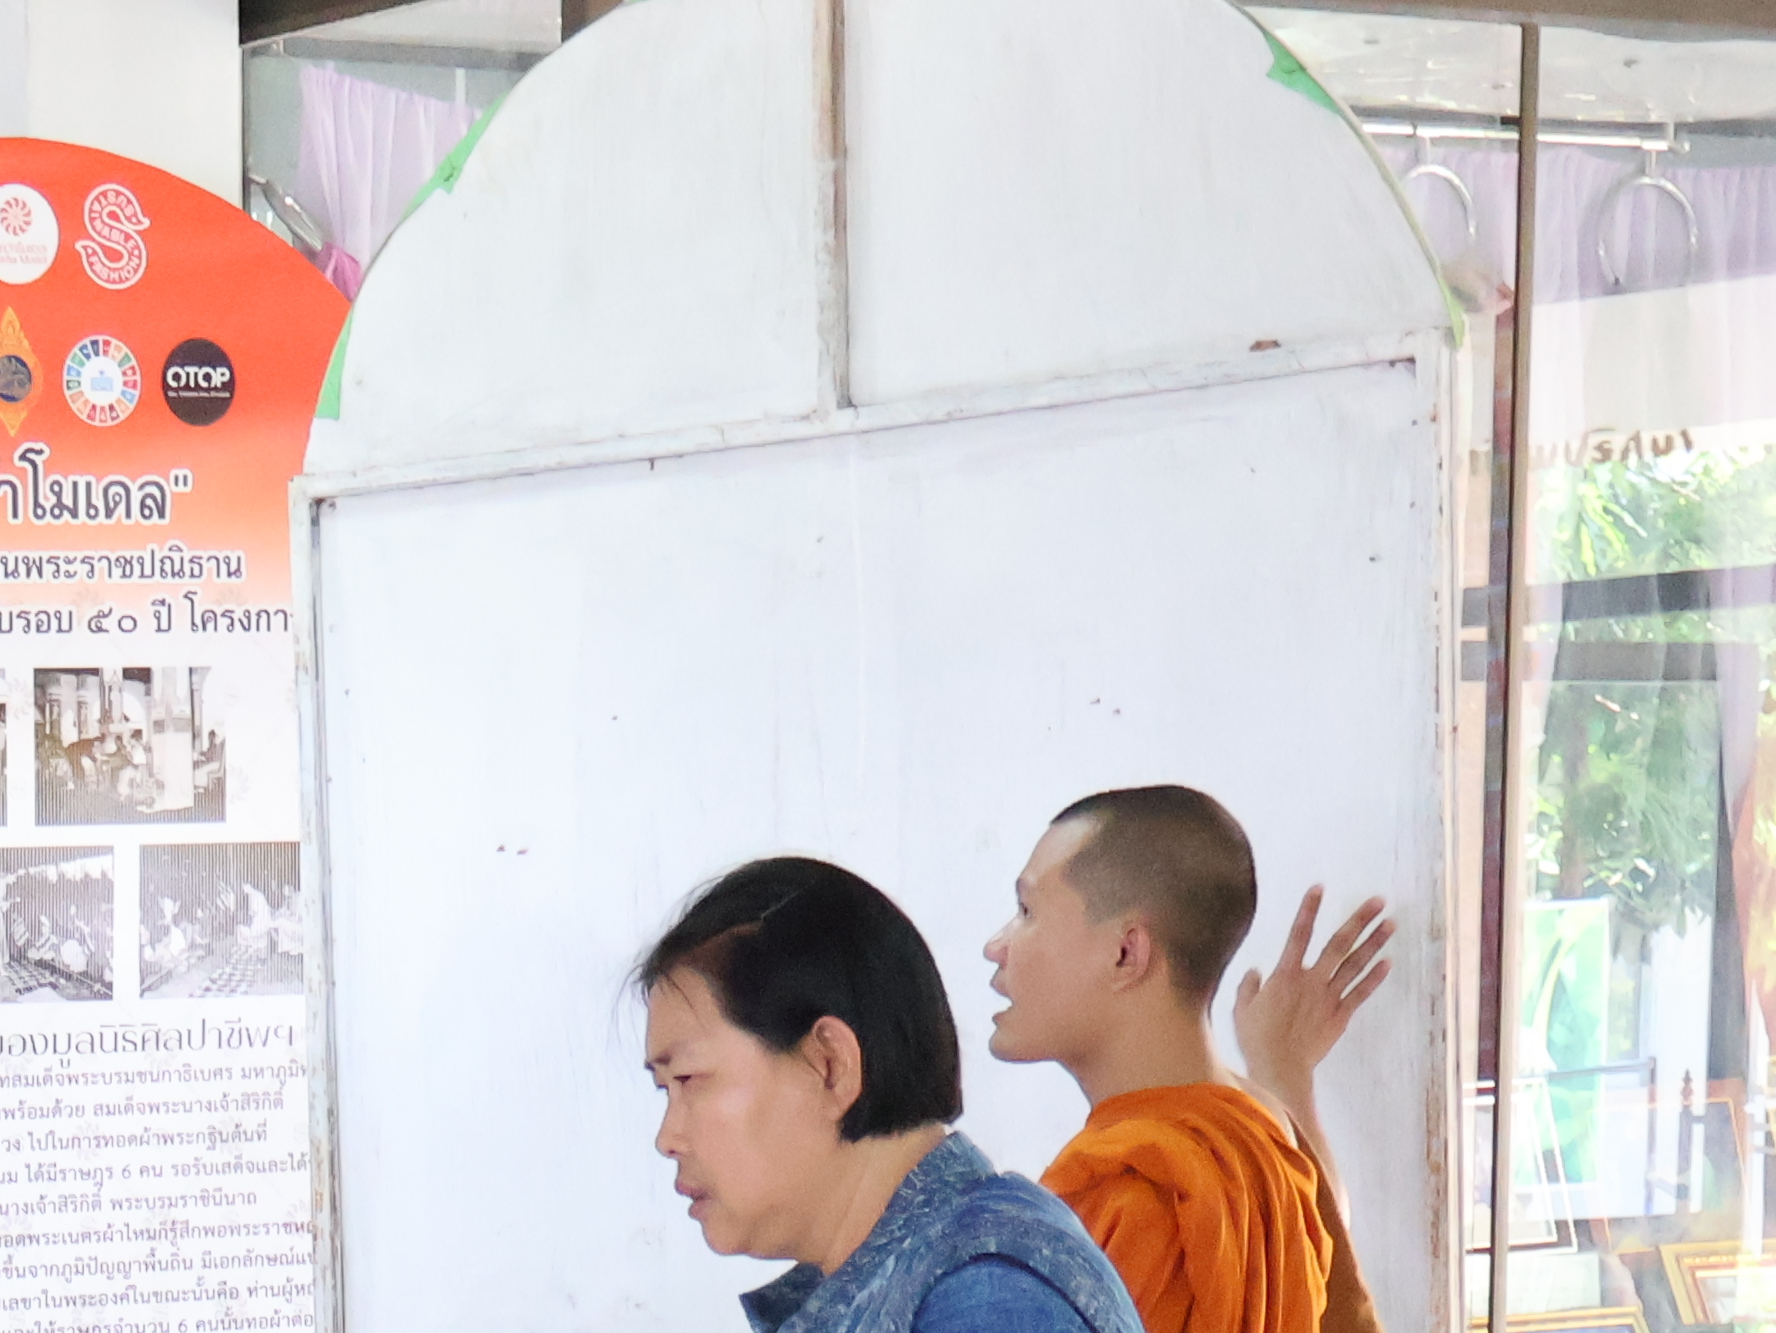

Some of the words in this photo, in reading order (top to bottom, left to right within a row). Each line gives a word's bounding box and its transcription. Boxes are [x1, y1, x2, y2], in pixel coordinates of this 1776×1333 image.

[165, 364, 231, 388] OTOP
[86, 607, 140, 637] ๕๐
[153, 590, 173, 636] ปี
[186, 592, 294, 637] โครงกา
[24, 1162, 114, 1189] ได้มีราษฎร
[121, 1164, 133, 1180] 6
[139, 1163, 164, 1179] คน
[170, 1152, 312, 1179] รอรับเสด็จและได้
[109, 1187, 258, 1213] พระบรมราชินีนาถ
[177, 1319, 188, 1333] 6
